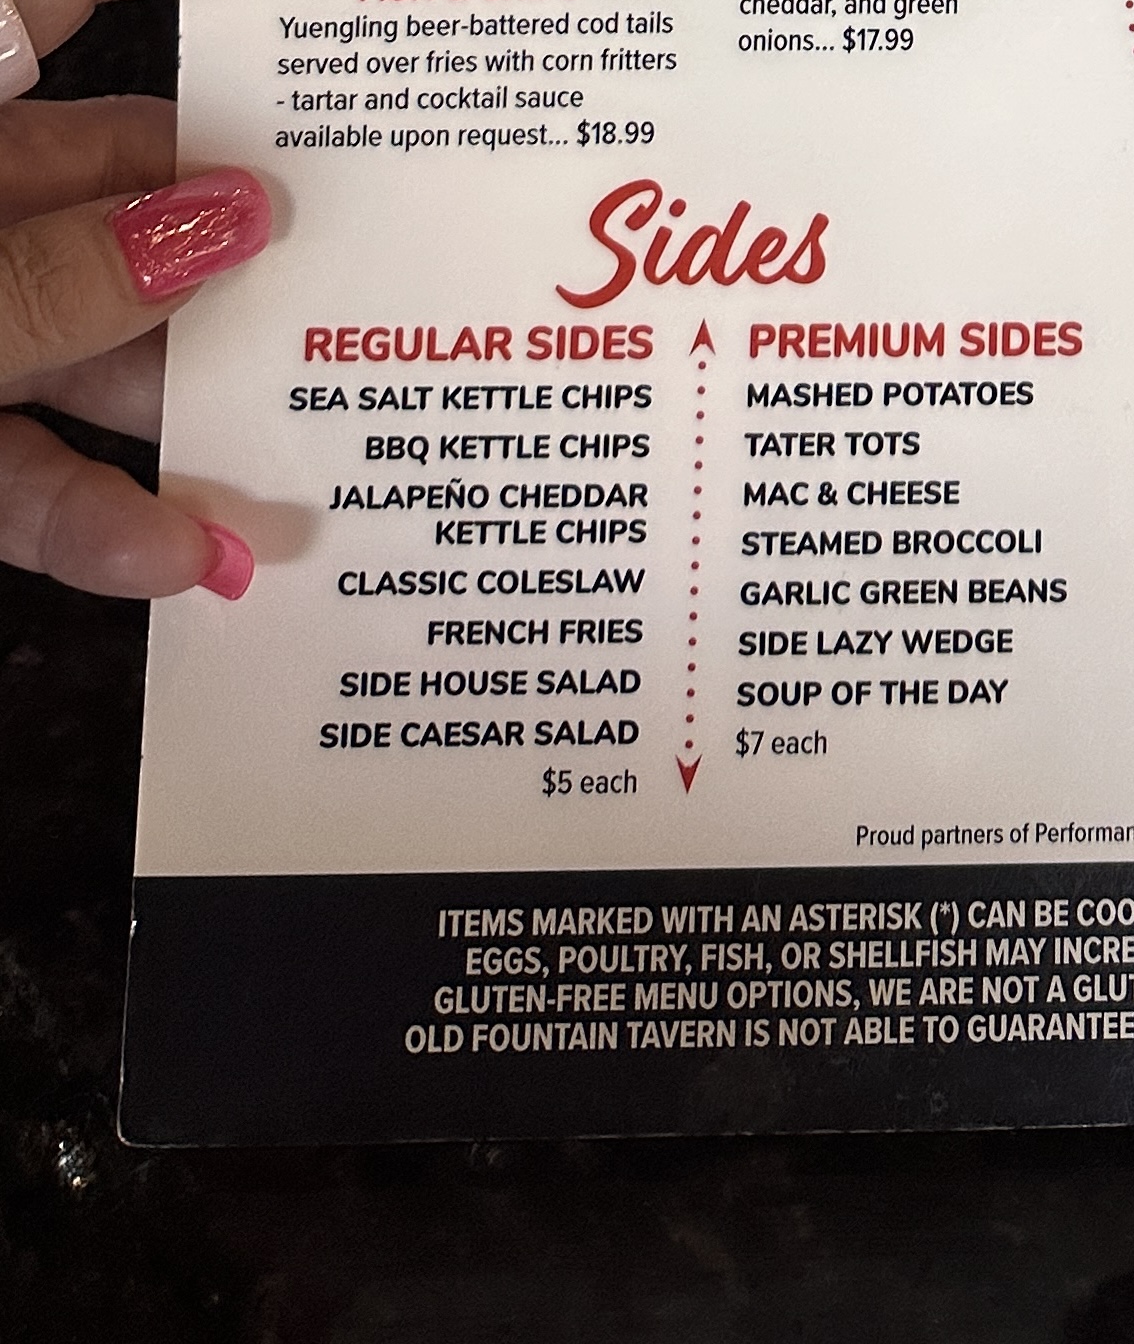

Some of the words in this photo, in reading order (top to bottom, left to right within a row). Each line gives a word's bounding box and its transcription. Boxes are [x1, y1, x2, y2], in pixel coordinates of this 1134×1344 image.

[279, 14, 398, 44] Yuengling
[406, 12, 569, 37] beer-battered
[577, 11, 619, 35] cod
[626, 11, 674, 34] tails
[556, 179, 830, 310] Sides
[304, 326, 512, 363] REGULAR
[526, 325, 654, 361] SIDES
[749, 322, 945, 359] PREMIUM
[959, 321, 1083, 357] SIDES
[329, 478, 490, 510] JALAPEÑO
[499, 483, 648, 509] CHEDDAR
[744, 482, 809, 507] MAC
[817, 481, 838, 506] &
[847, 480, 960, 506] CHEESE
[542, 766, 573, 798] $5
[580, 769, 637, 794] each
[856, 825, 914, 847] Proud
[921, 825, 1004, 851] partners
[1010, 822, 1030, 844] of
[405, 1024, 464, 1054] OLD
[472, 1021, 618, 1052] FOUNTAIN
[626, 1019, 736, 1049] TAVERN
[745, 1018, 771, 1047] IS
[779, 1017, 837, 1046] NOT
[843, 1015, 915, 1045] ABLE
[922, 1014, 959, 1044] TO
[967, 1011, 1134, 1043] GUARANTEE
